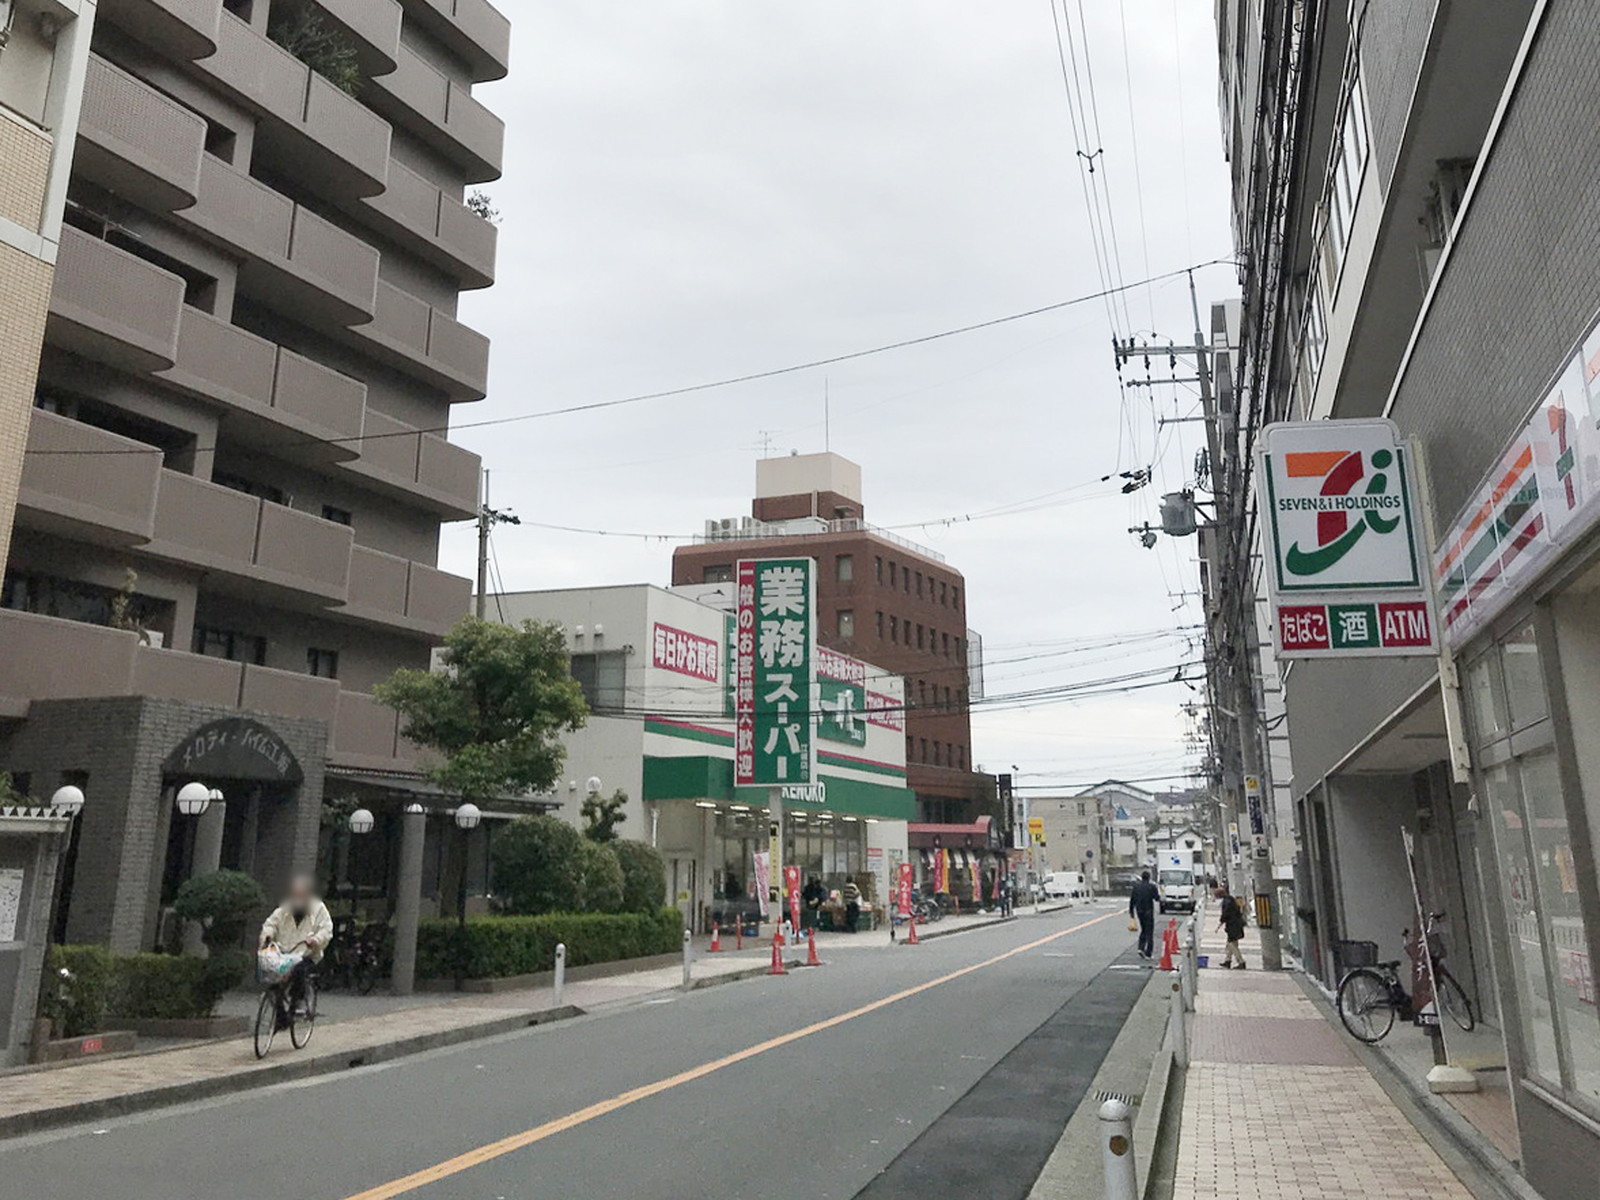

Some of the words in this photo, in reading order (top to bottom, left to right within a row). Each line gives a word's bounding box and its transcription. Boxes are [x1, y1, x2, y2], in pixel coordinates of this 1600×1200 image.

[1279, 496, 1333, 511] SEVEN&i
[1336, 495, 1401, 511] HOLDINGS
[1281, 611, 1327, 644] たばこ
[1338, 611, 1369, 643] 酒
[1385, 610, 1428, 641] ATM
[655, 627, 717, 678] 毎日がお買得
[738, 569, 755, 777] 一般のお客様大歓迎
[759, 566, 806, 779] 業務スーパー
